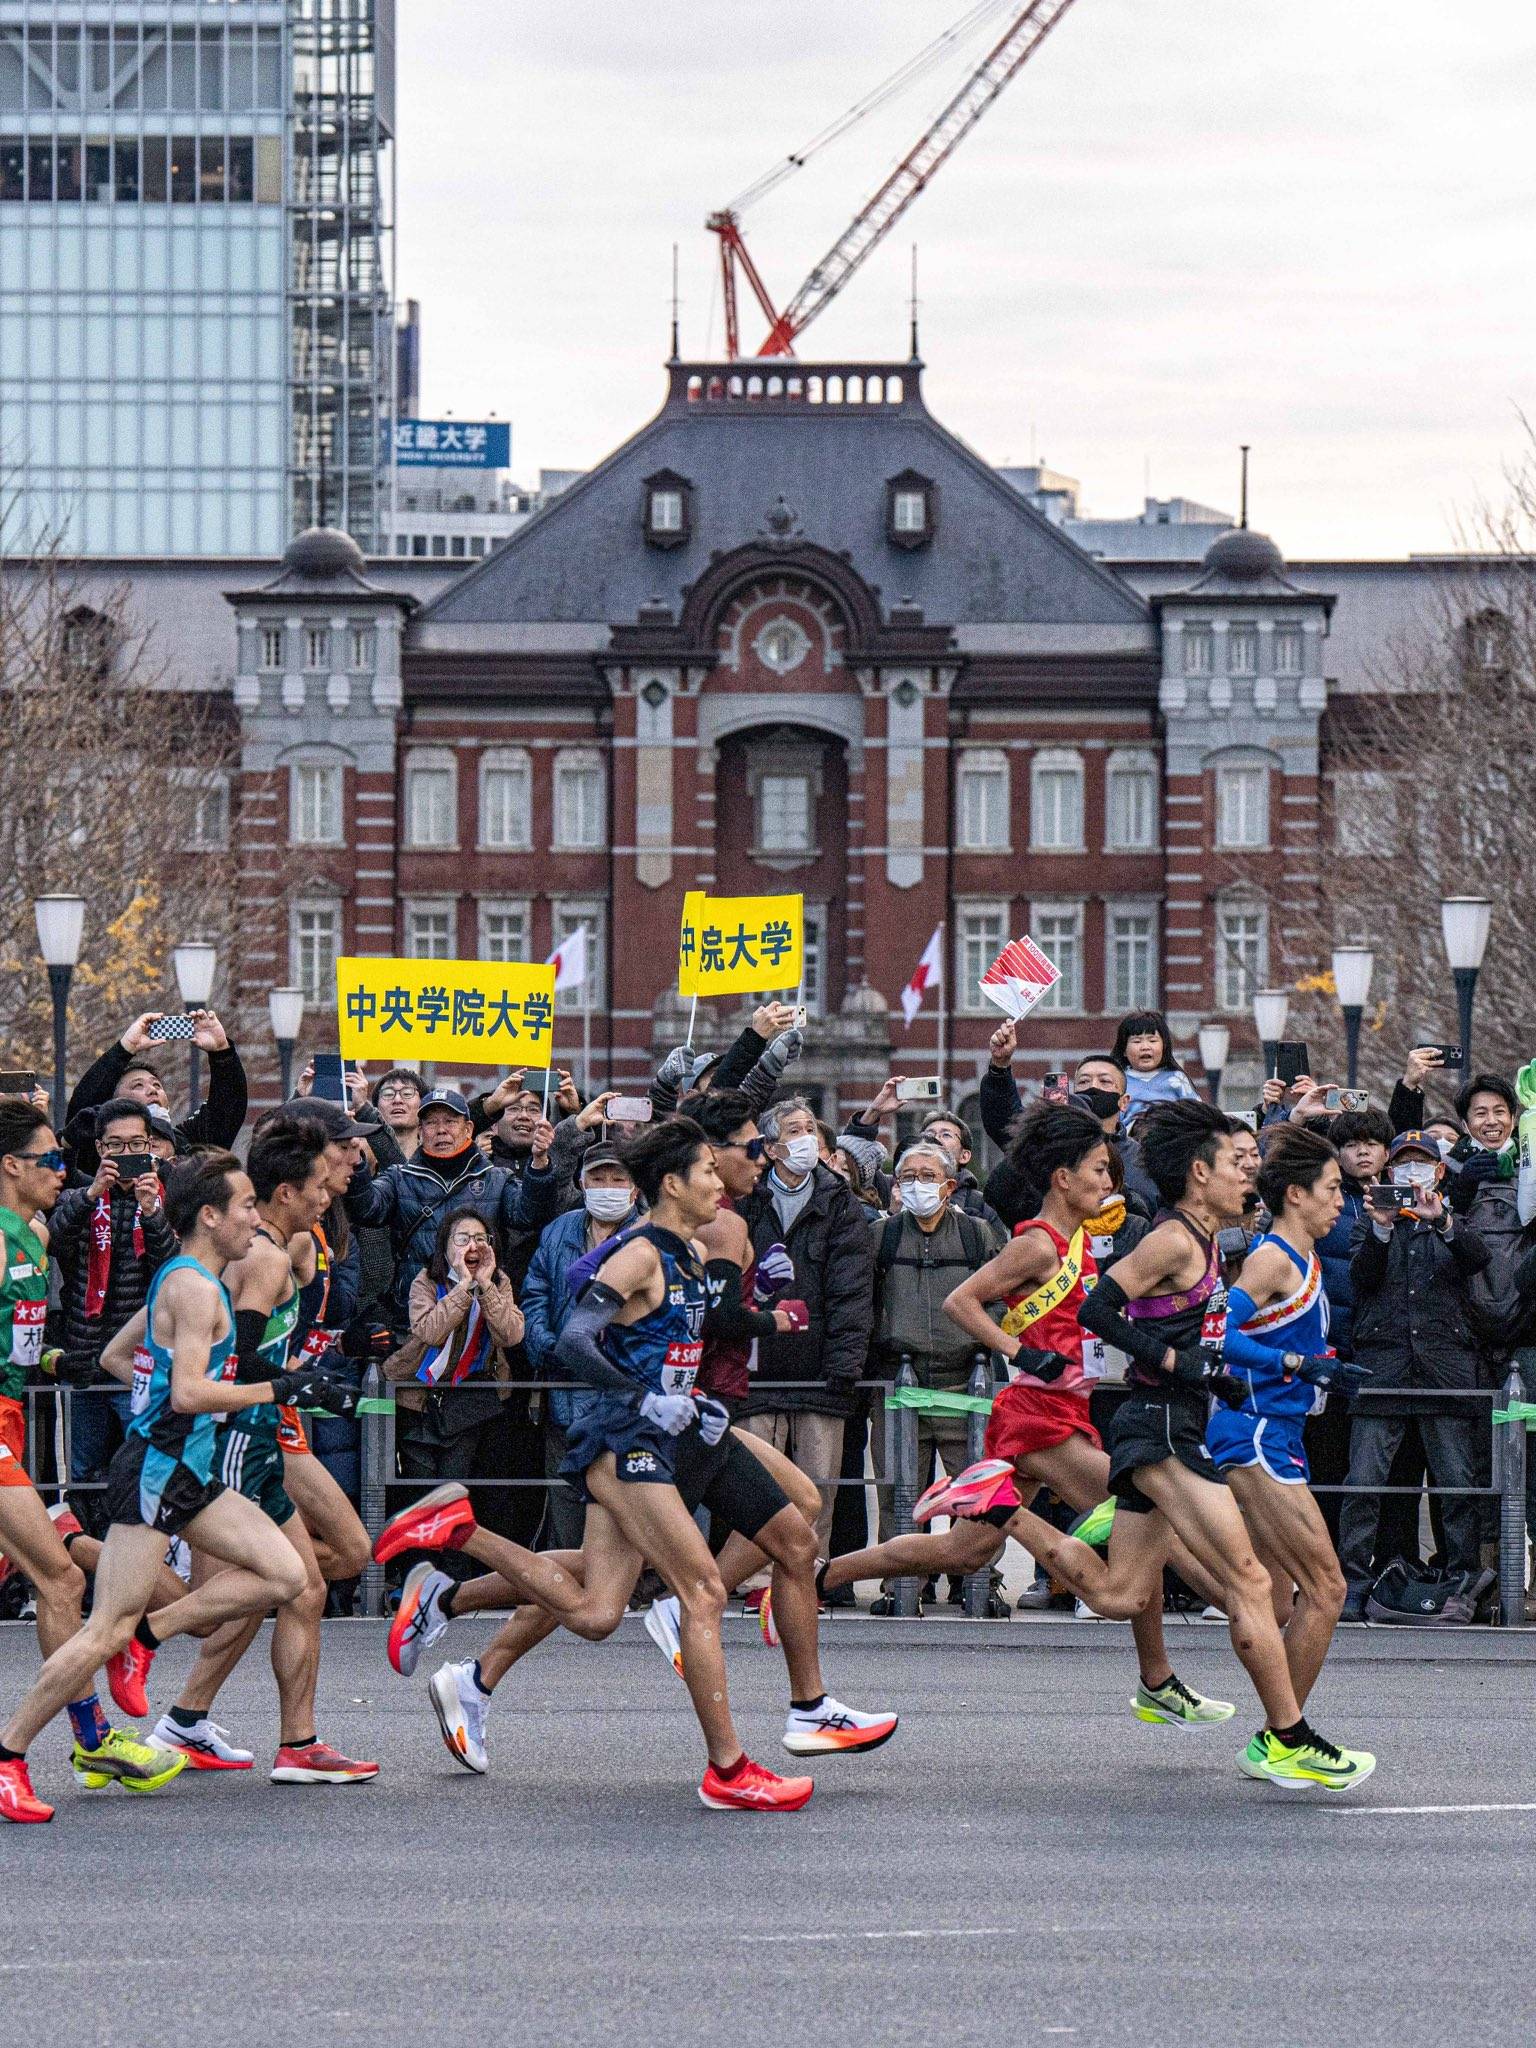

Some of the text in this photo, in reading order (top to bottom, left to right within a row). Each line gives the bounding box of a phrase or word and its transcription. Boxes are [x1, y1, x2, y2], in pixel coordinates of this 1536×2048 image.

[347, 984, 552, 1041] 中央学院大学
